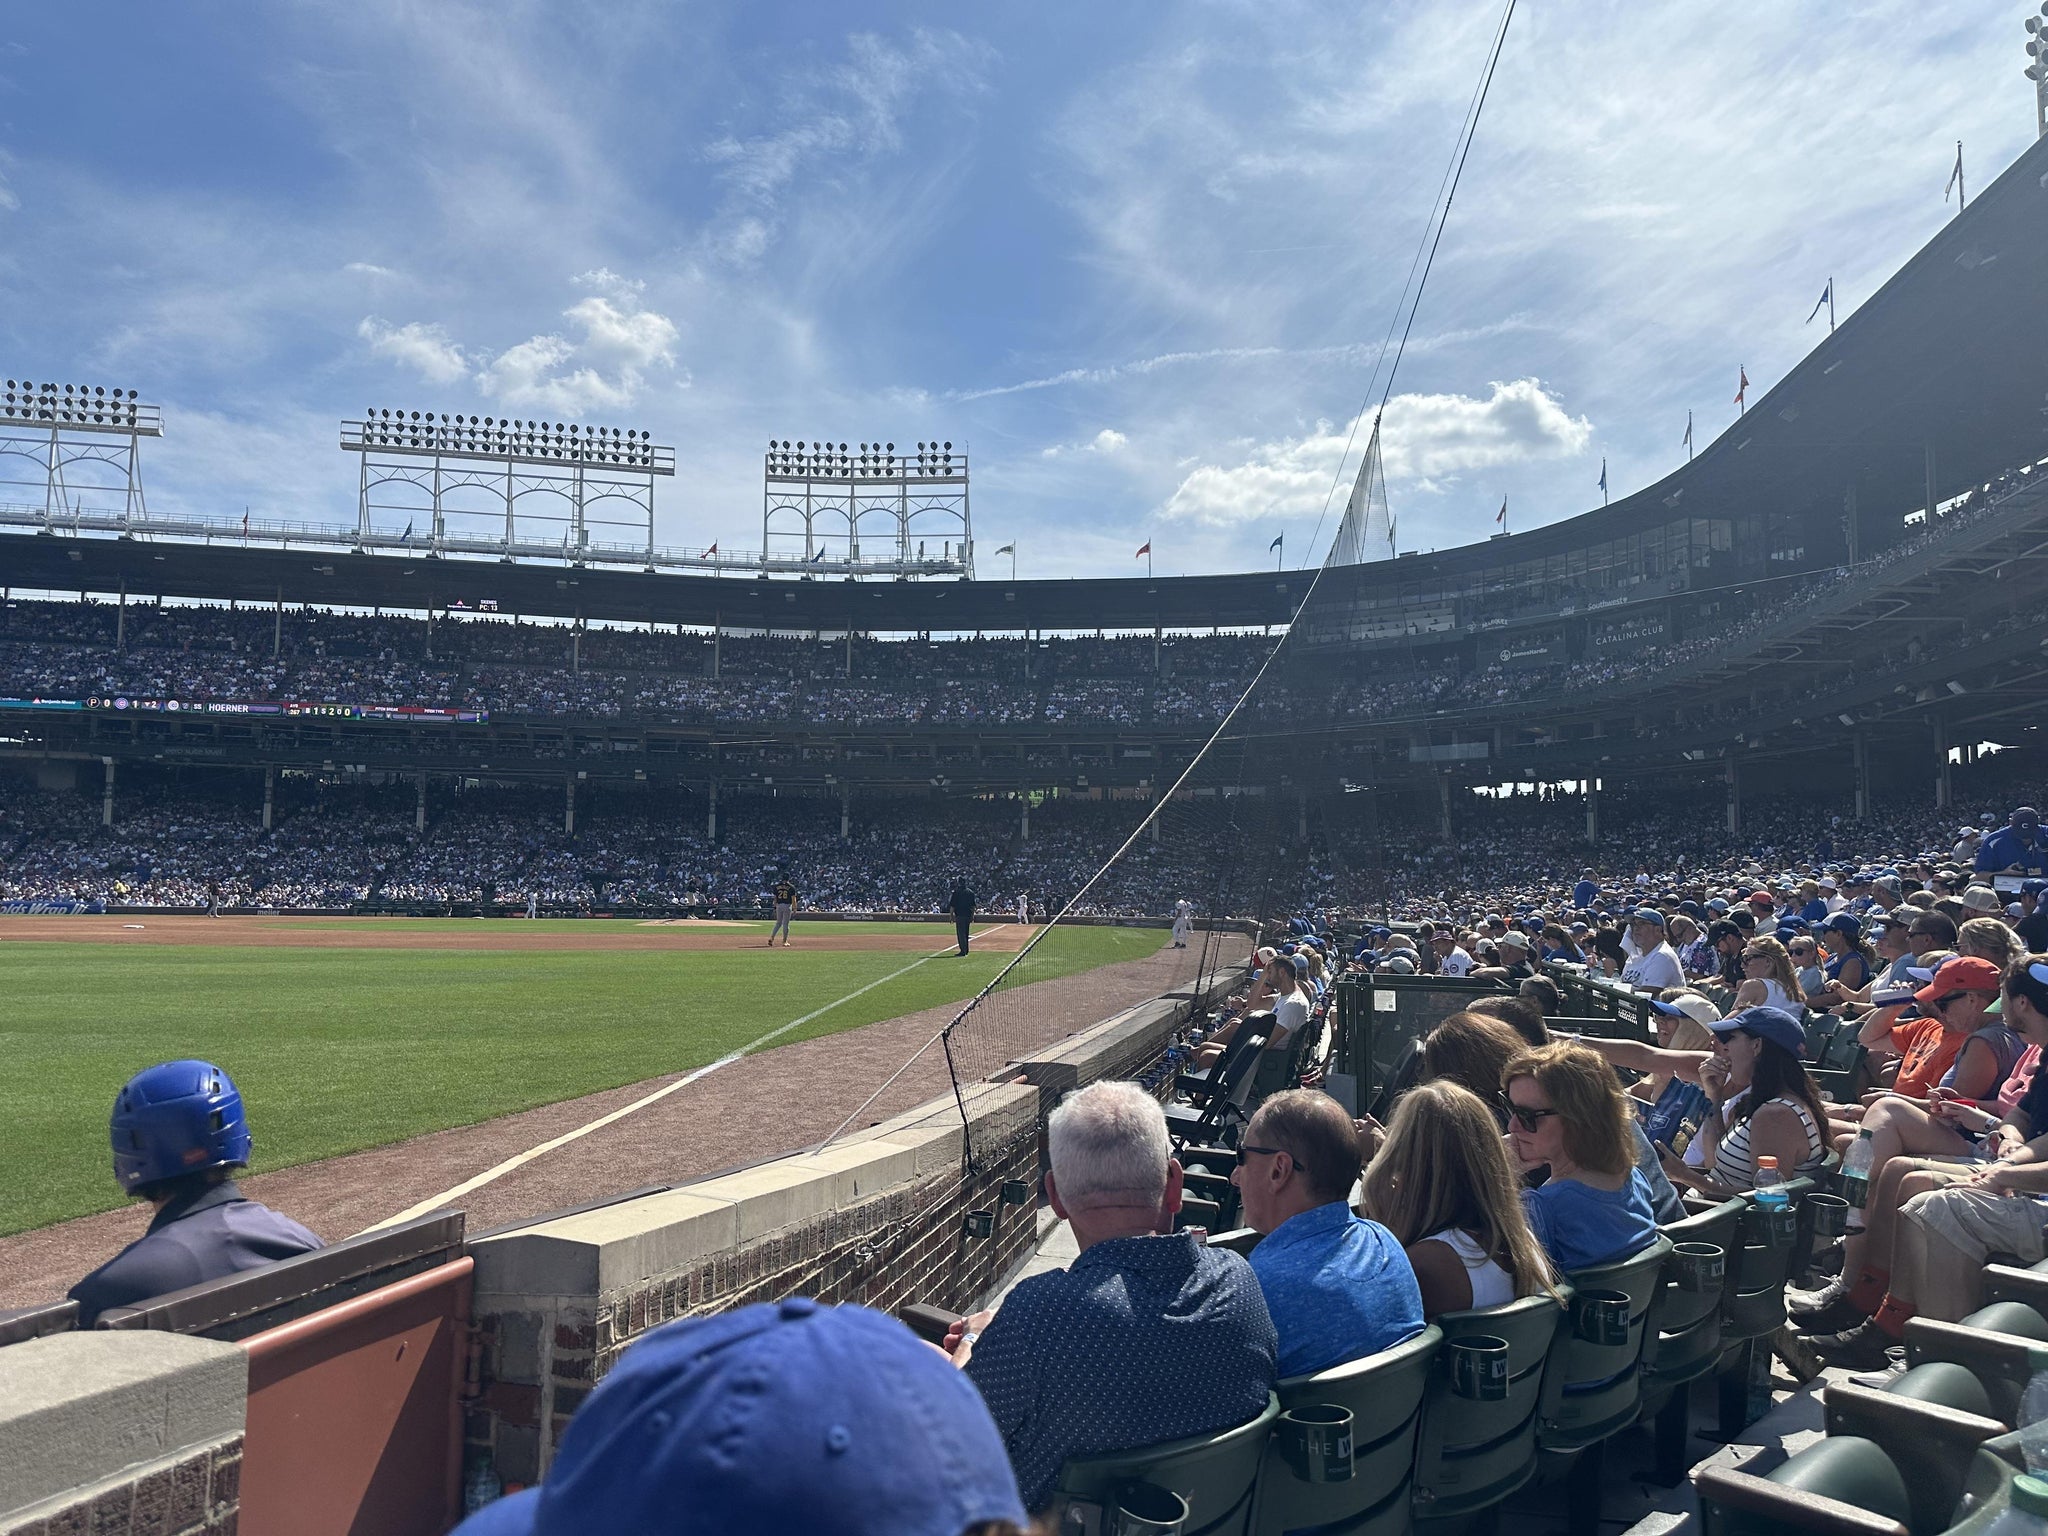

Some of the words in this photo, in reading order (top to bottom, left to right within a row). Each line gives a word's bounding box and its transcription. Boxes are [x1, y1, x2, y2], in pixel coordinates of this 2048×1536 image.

[1587, 598, 1624, 611] Southwest
[1595, 630, 1639, 646] CATALINA
[1641, 624, 1664, 636] CLUB
[1511, 648, 1548, 658] JamesHardie
[104, 699, 110, 707] 0
[133, 700, 138, 708] 1
[151, 700, 157, 709] 2
[208, 703, 249, 713] HOERNER
[328, 707, 335, 716] 2
[28, 903, 68, 914] Wrap
[257, 908, 280, 916] meijer
[1299, 1438, 1332, 1456] THE
